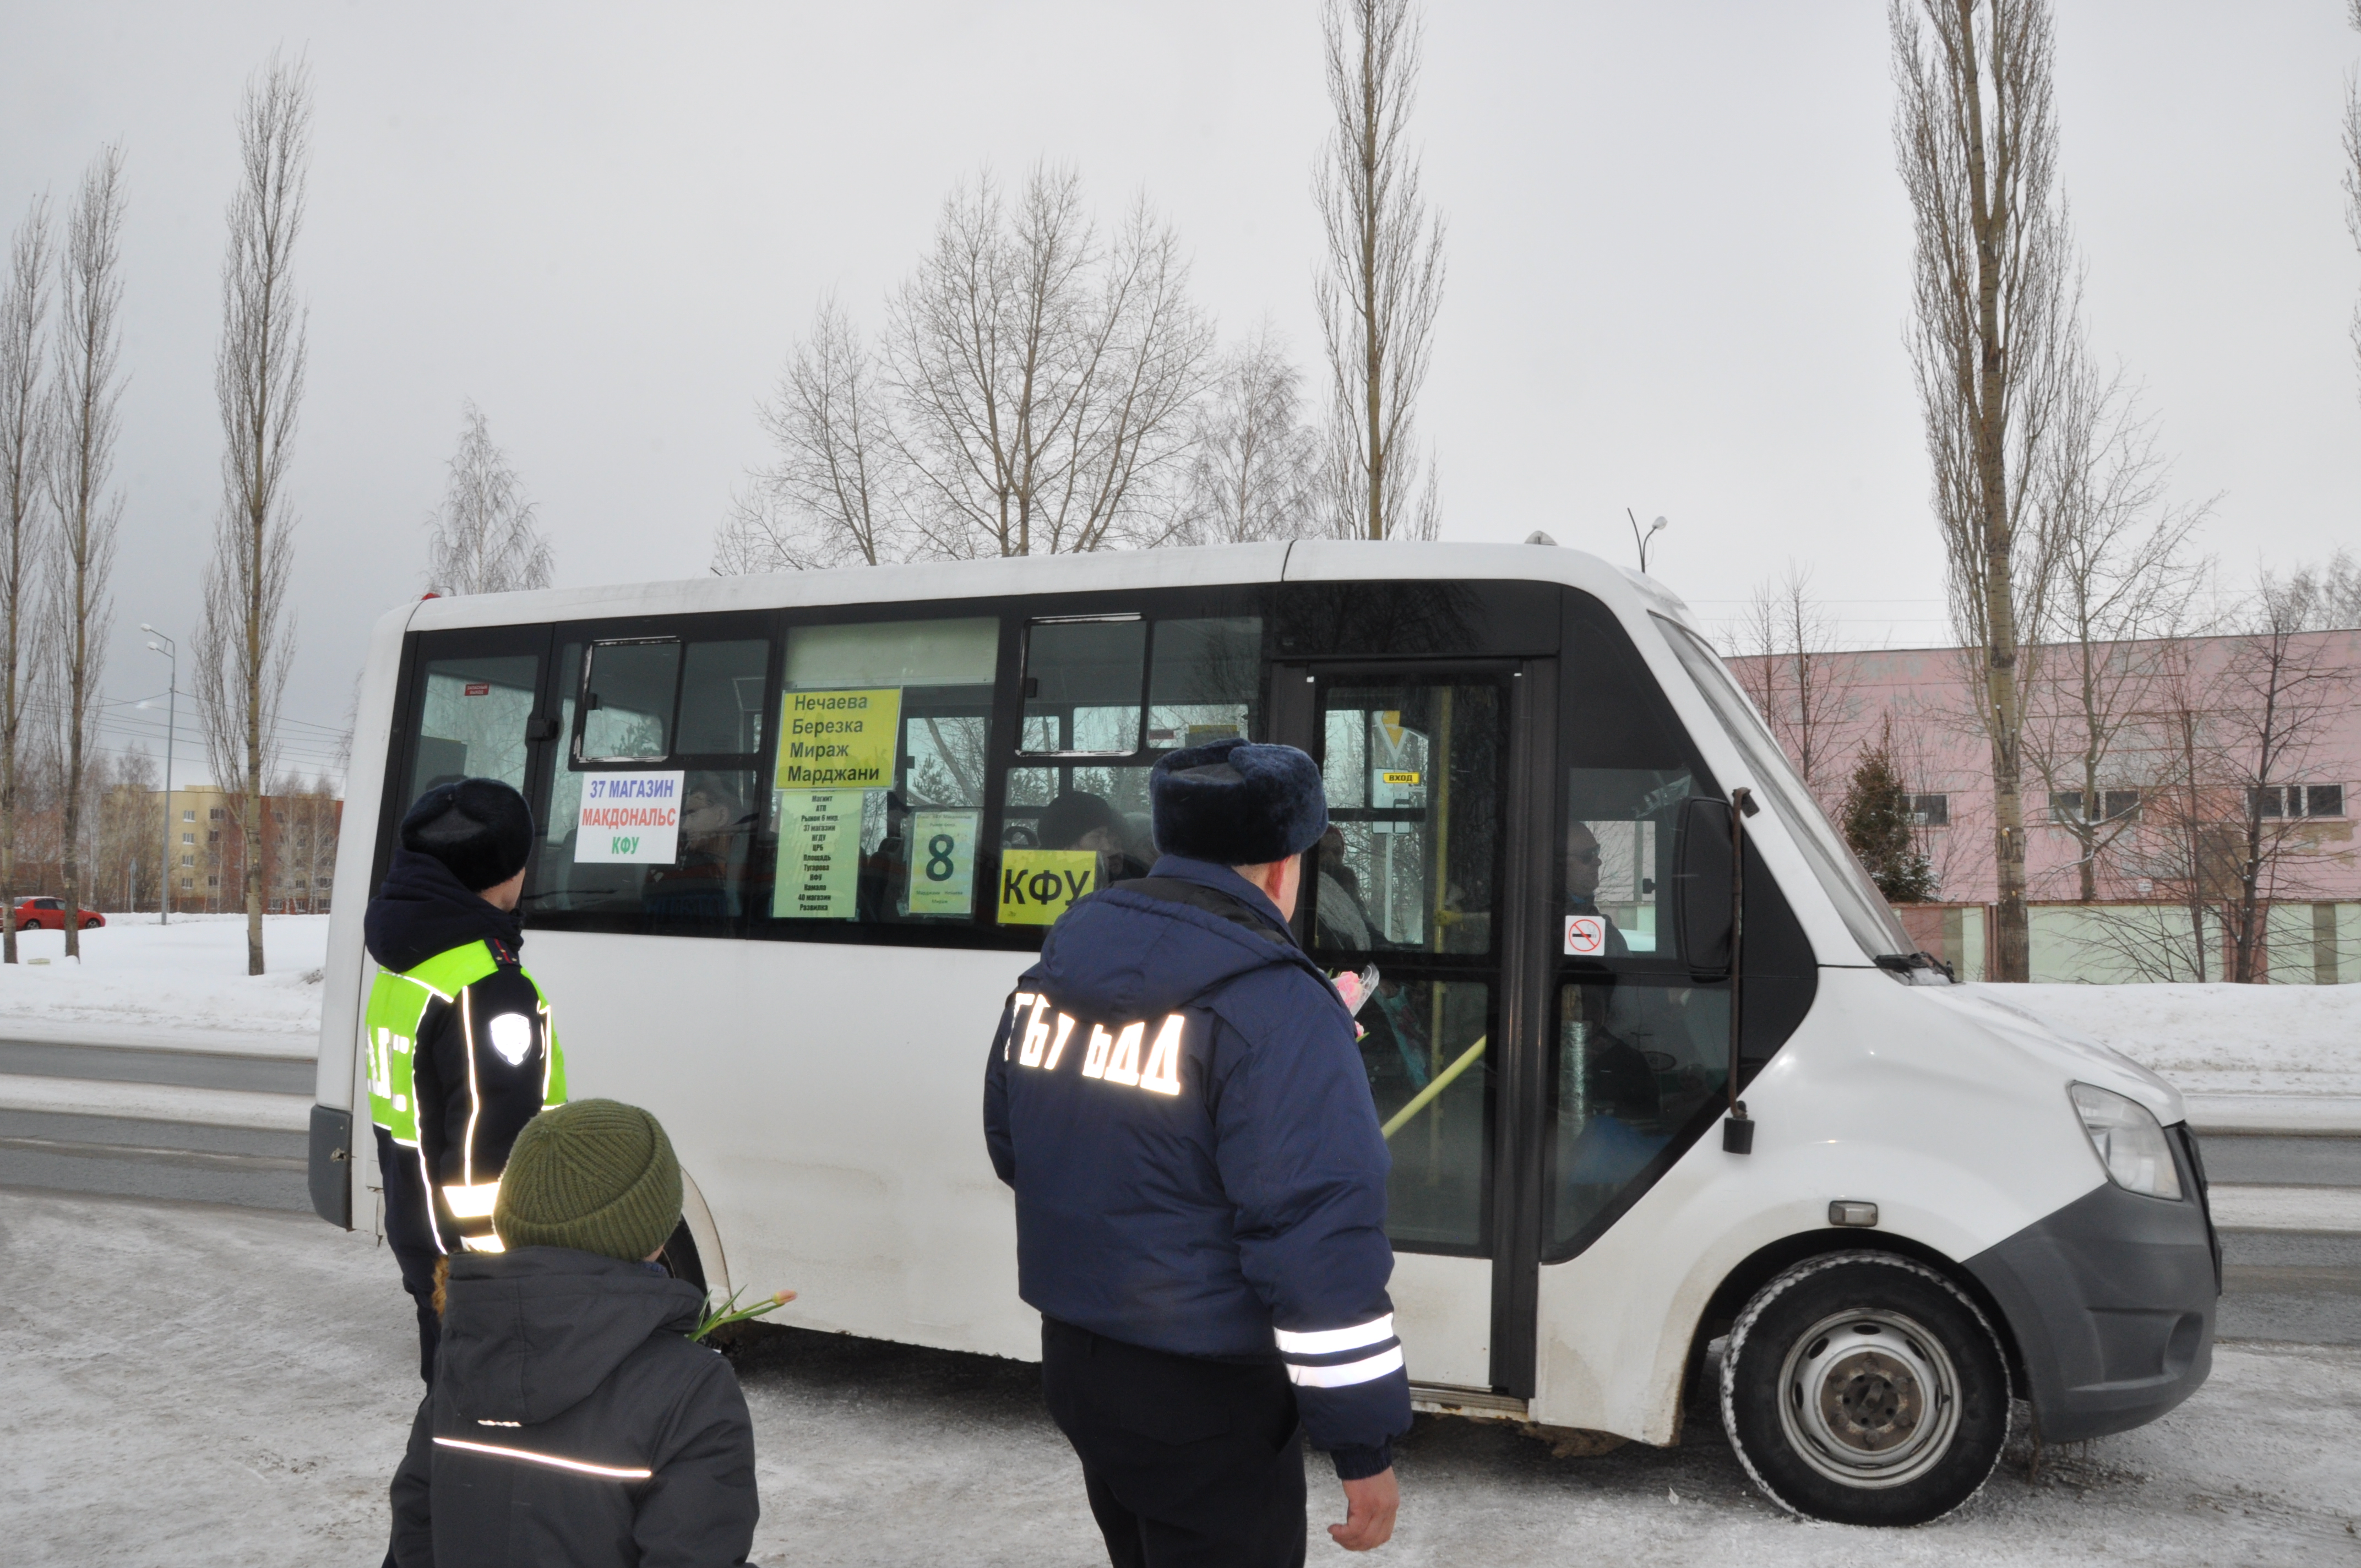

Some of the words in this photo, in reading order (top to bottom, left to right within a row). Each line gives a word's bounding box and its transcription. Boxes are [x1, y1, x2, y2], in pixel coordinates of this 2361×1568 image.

[794, 694, 868, 711] Нечаева
[792, 719, 863, 737] Березка
[790, 742, 848, 760] Мираж
[787, 766, 879, 785] Марджани
[590, 780, 605, 798] 37
[608, 780, 674, 798] МАГАЗИН
[582, 807, 676, 829] МАКДОНАЛЬС
[612, 836, 639, 854] КФУ
[926, 834, 955, 881] 8
[1003, 868, 1091, 905] КФУ
